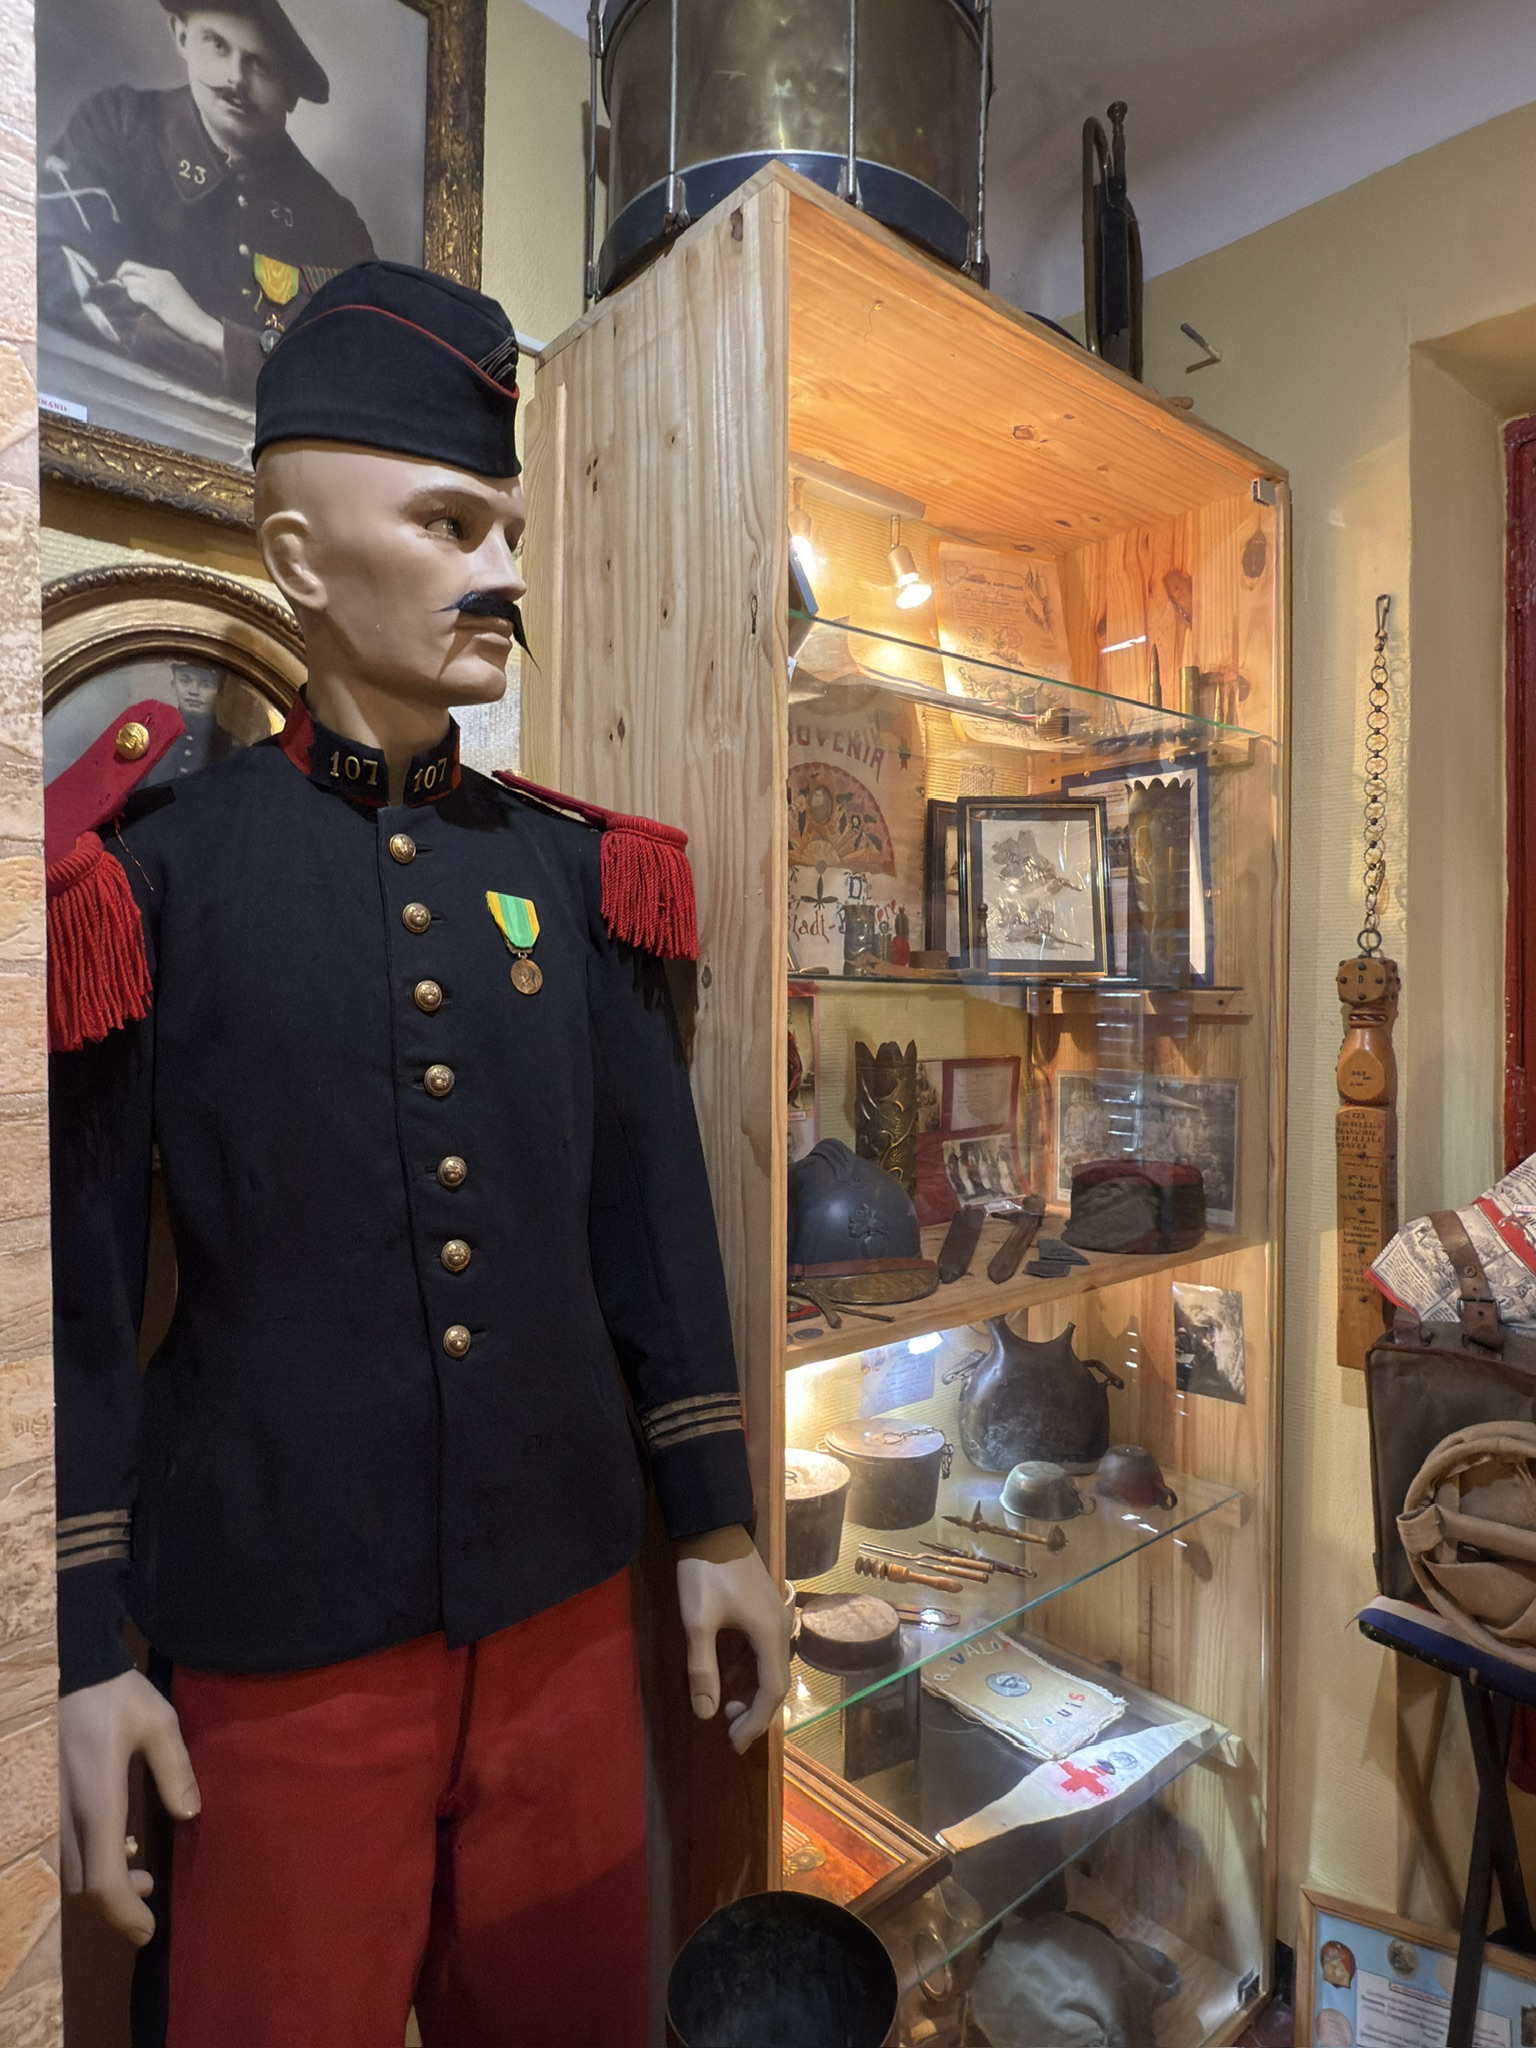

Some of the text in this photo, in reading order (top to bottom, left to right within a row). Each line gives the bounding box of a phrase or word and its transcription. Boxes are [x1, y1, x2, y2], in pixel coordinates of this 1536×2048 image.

[179, 160, 207, 184] 23
[329, 751, 378, 786] 107
[413, 757, 448, 793] 107
